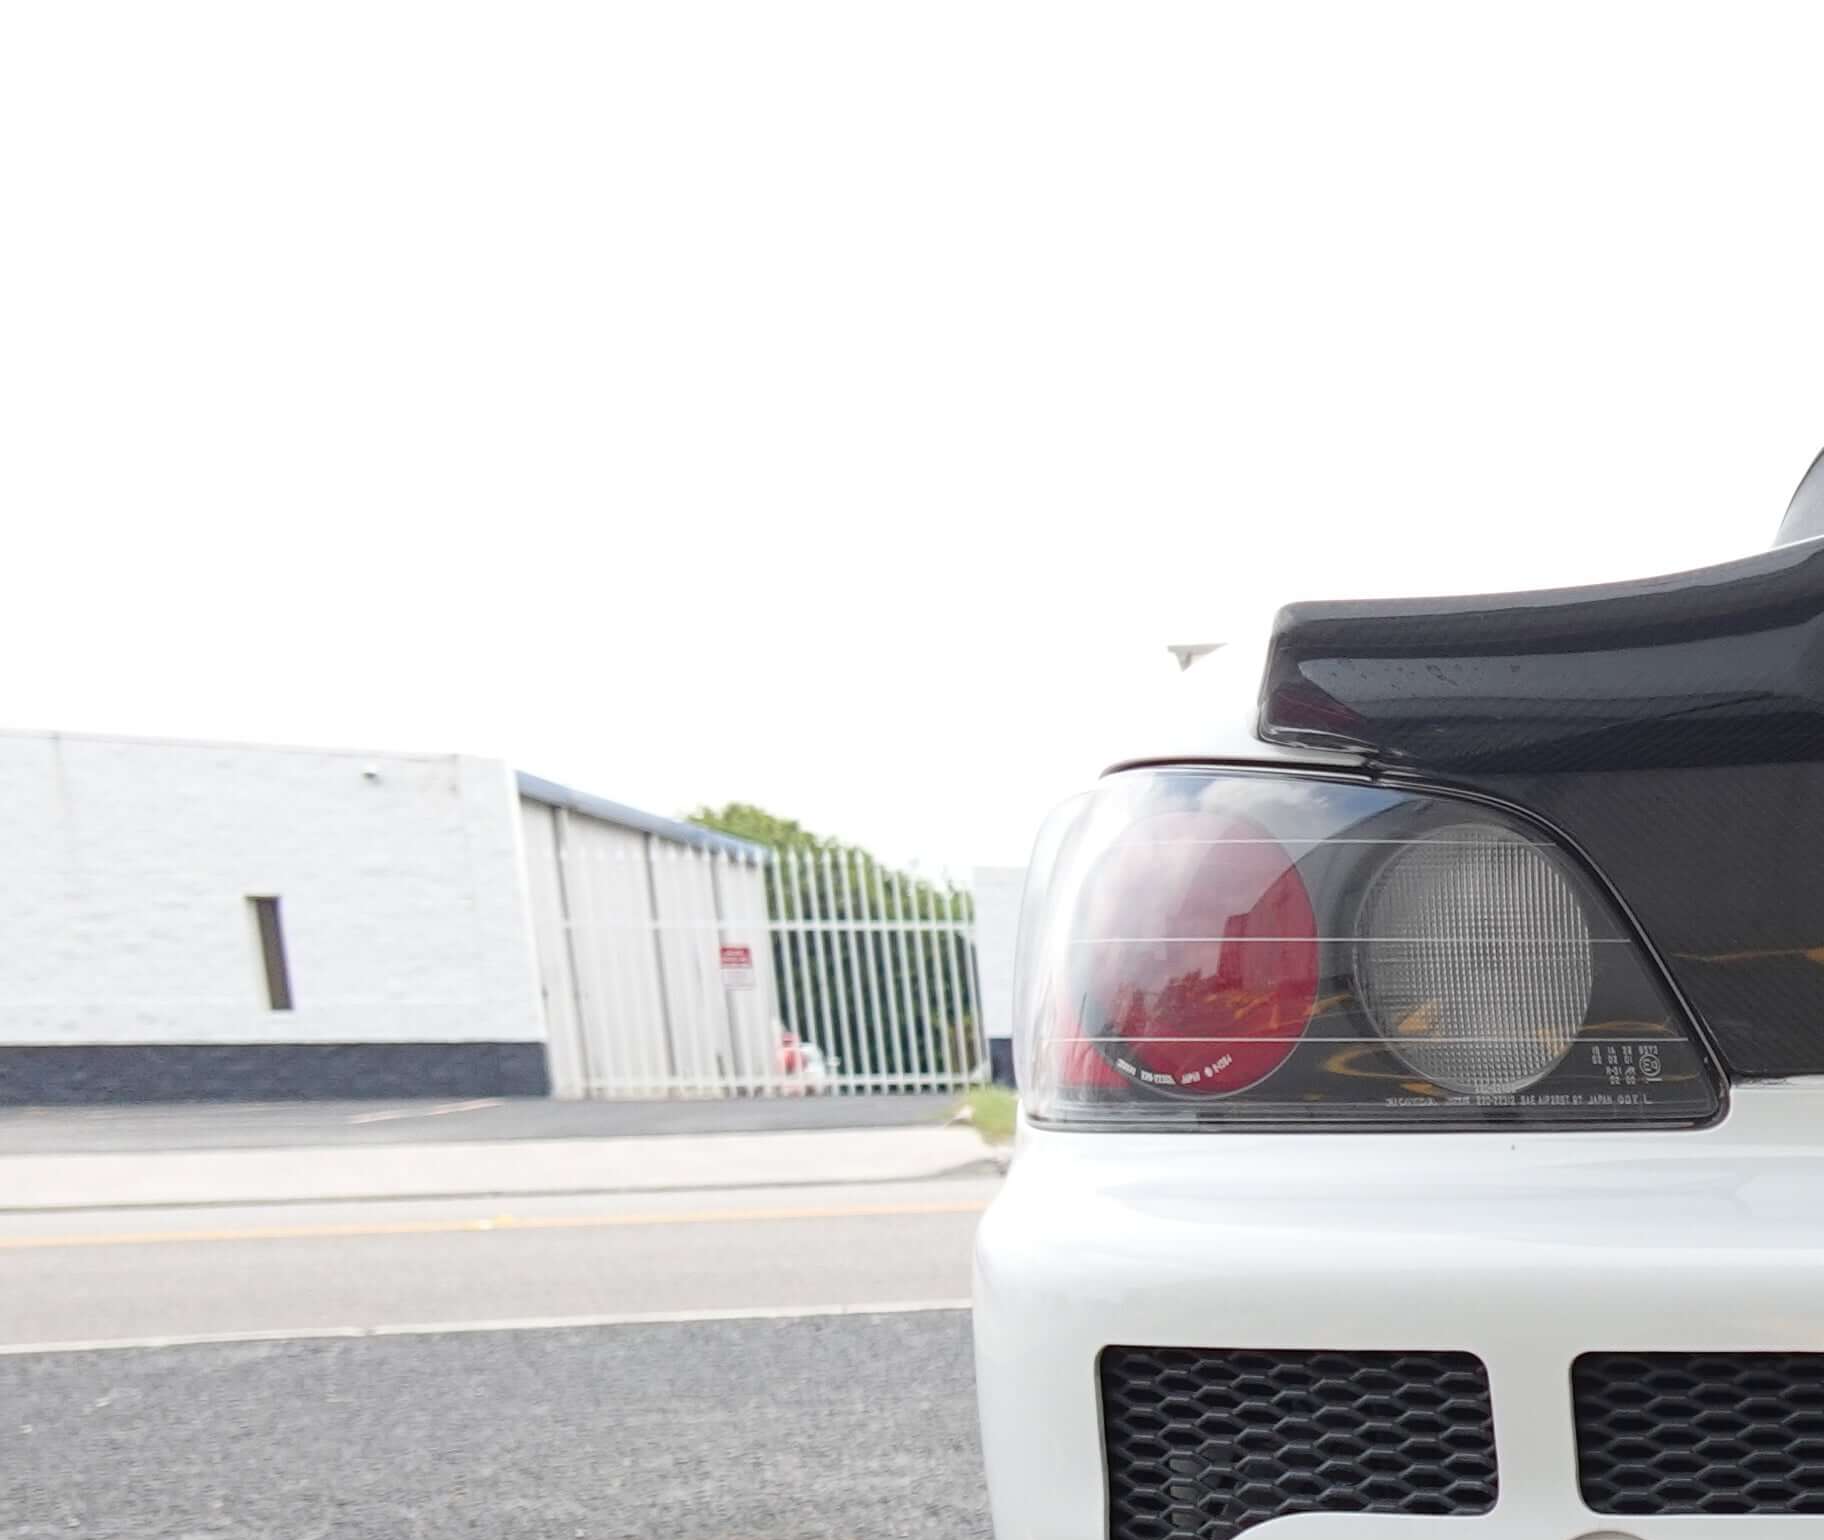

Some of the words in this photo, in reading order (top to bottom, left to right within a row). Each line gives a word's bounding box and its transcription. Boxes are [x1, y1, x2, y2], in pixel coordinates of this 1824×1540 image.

[1587, 1095, 1613, 1105] JAPAN
[1617, 1094, 1639, 1105] DOT
[1642, 1093, 1653, 1105] L
